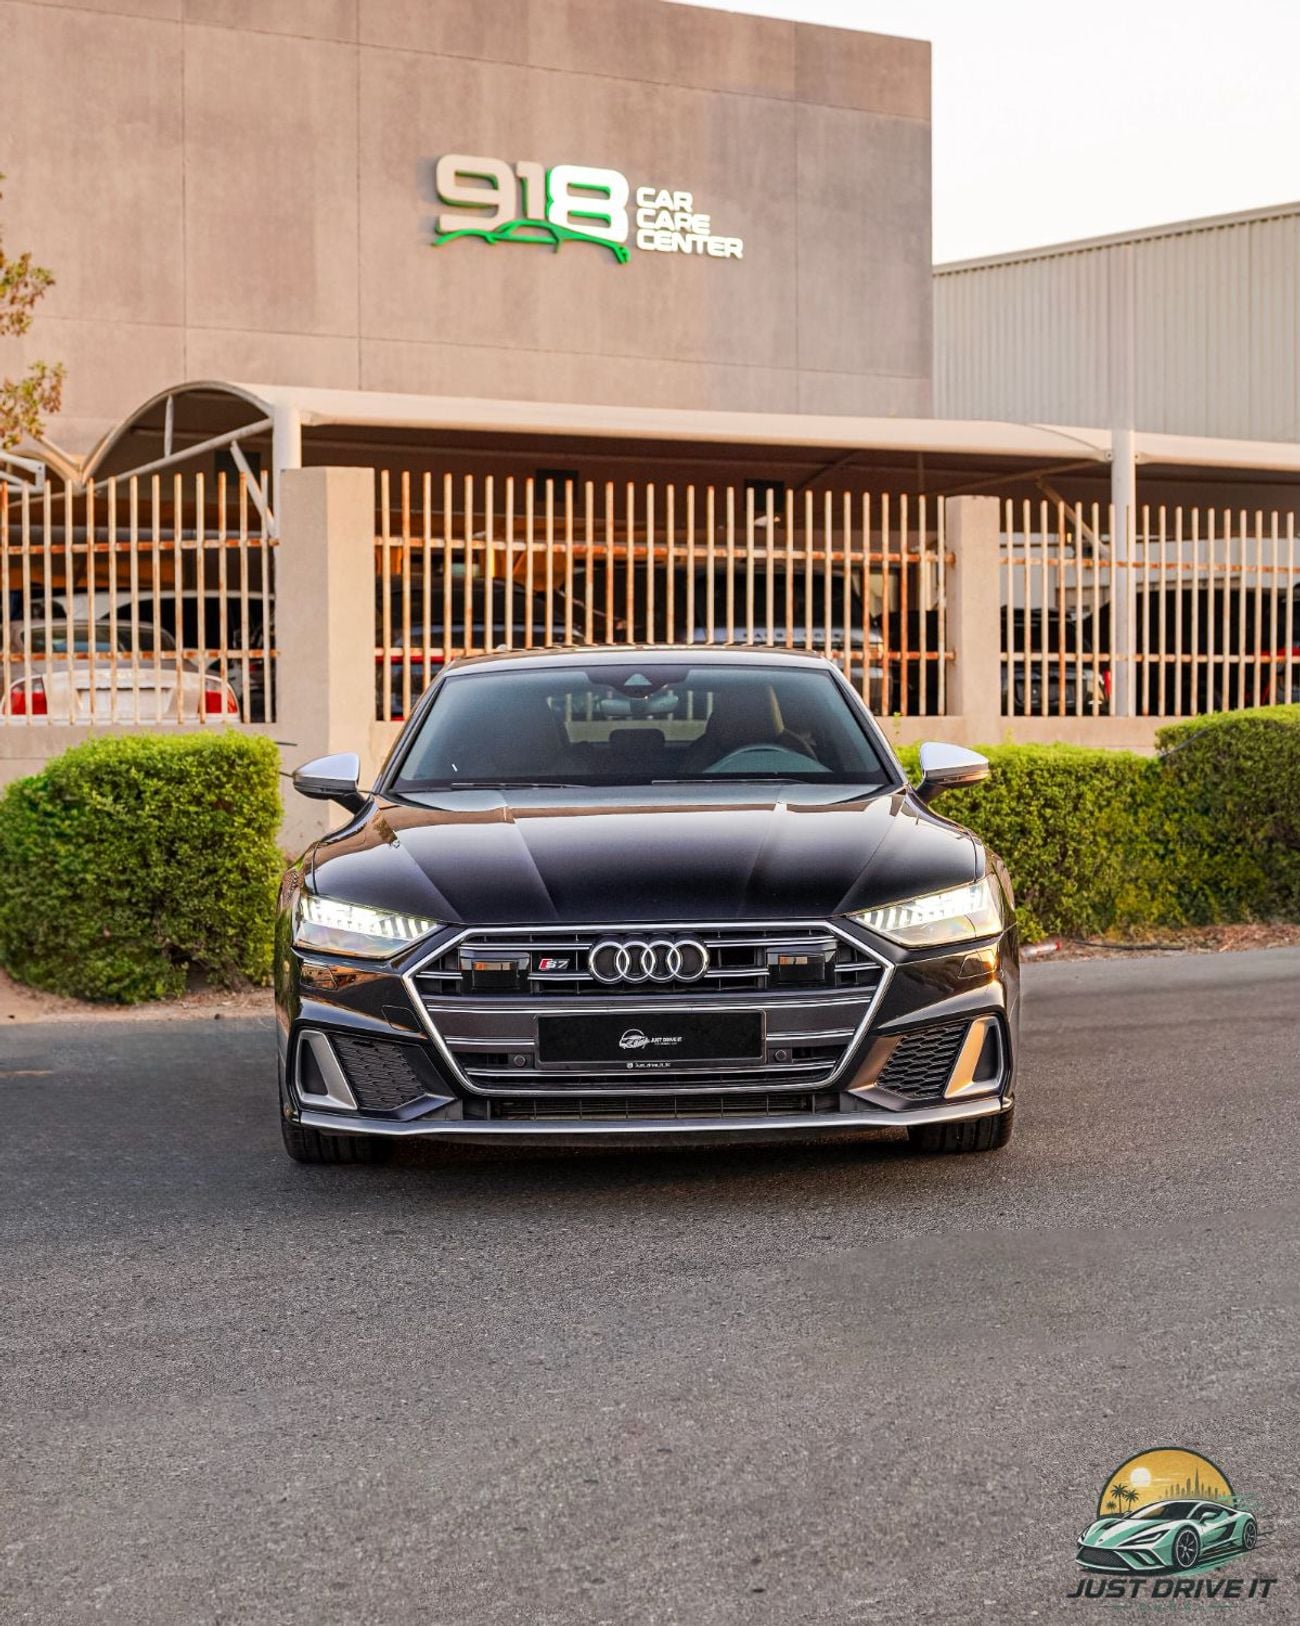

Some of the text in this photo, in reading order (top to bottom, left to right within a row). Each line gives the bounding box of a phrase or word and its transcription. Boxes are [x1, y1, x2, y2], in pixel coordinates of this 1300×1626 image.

[436, 154, 630, 243] 918
[636, 187, 693, 212] CAR
[636, 208, 711, 235] CARE
[636, 229, 743, 259] CENTER
[542, 959, 569, 970] S7
